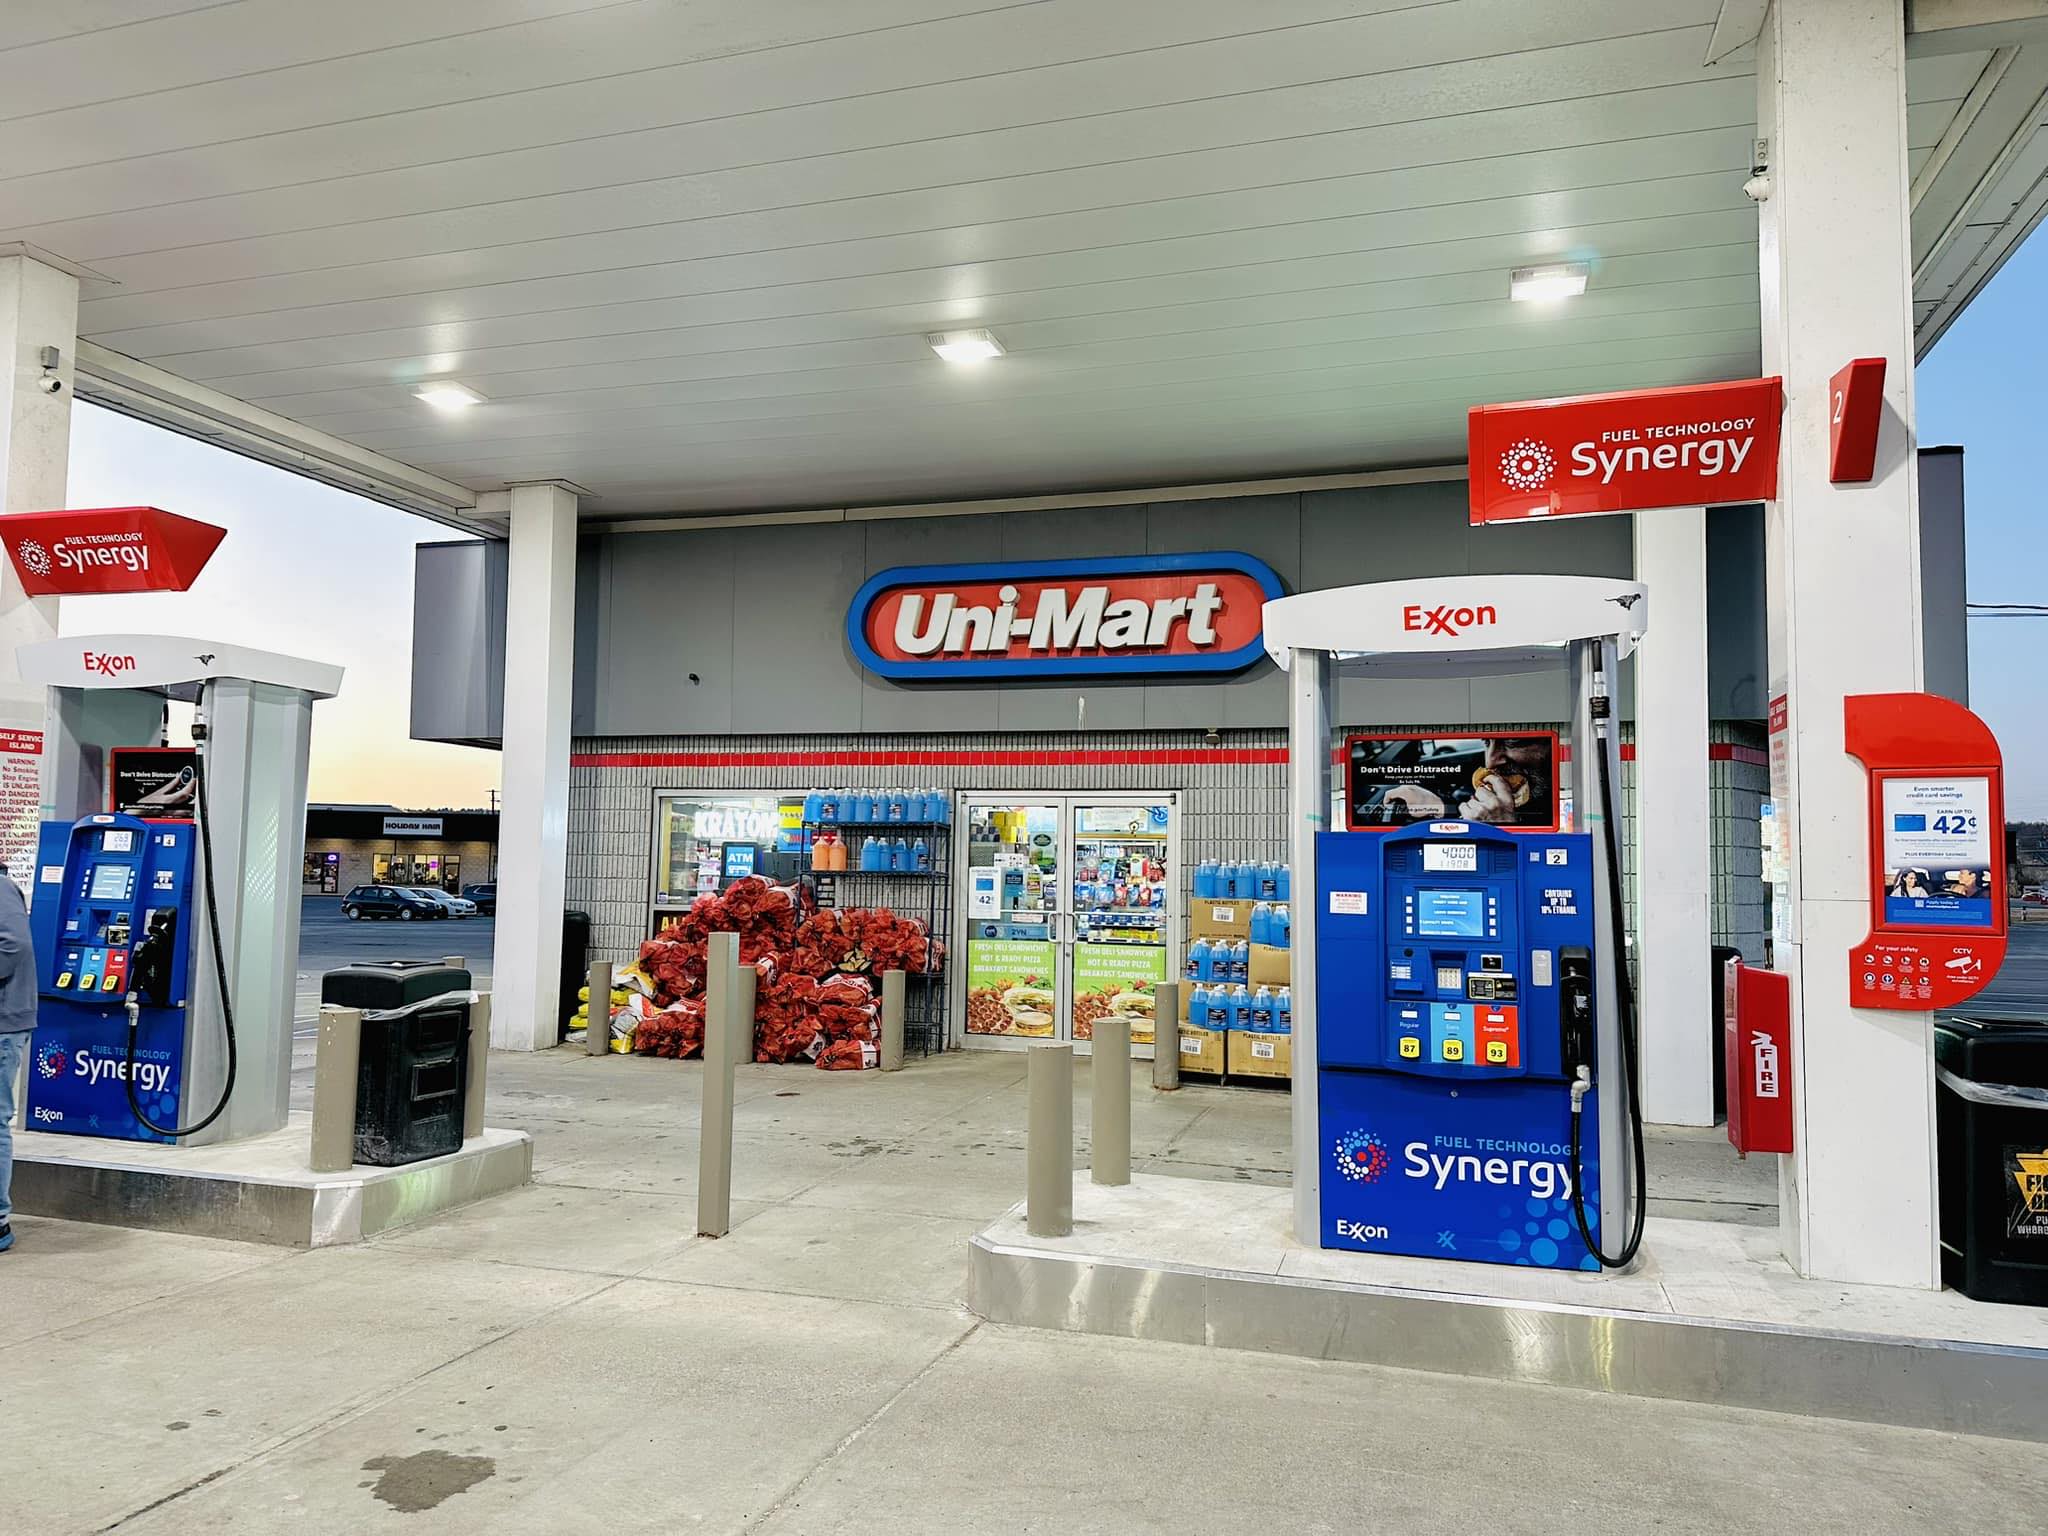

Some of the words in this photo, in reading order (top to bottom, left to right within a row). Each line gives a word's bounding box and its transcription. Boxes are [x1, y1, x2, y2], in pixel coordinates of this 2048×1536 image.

[1833, 391, 1842, 425] 2
[1602, 430, 1640, 443] FUEL
[1645, 418, 1756, 438] TECHNOLOGY
[1570, 436, 1754, 485] Synergy
[65, 536, 86, 545] FUEL
[86, 532, 144, 544] TECHNOLOGY
[53, 544, 148, 574] Synergy
[894, 583, 1221, 654] Uni-Mart
[1404, 605, 1496, 636] Exxon
[83, 652, 136, 677] Exxon
[1414, 765, 1462, 773] Distracted
[694, 808, 778, 838] KRATOM
[727, 854, 753, 863] ATM
[1553, 854, 1560, 864] 2
[1544, 889, 1572, 898] CONTAINS
[1550, 898, 1558, 906] UP
[1559, 898, 1568, 906] TO
[1552, 906, 1577, 914] ETHANOL
[92, 1045, 113, 1055] FUEL
[114, 1047, 171, 1060] TECNOLOGY
[1404, 1044, 1416, 1052] 87
[1446, 1046, 1459, 1055] 89
[1490, 1049, 1503, 1058] 93
[74, 1050, 170, 1092] Synergy
[1760, 1048, 1774, 1093] FIRE
[34, 1106, 63, 1123] Exxon
[1434, 1136, 1472, 1149] FUEL
[1476, 1138, 1582, 1156] TECHNOLOG
[1404, 1142, 1583, 1200] Synergy
[1336, 1219, 1388, 1242] Exxon
